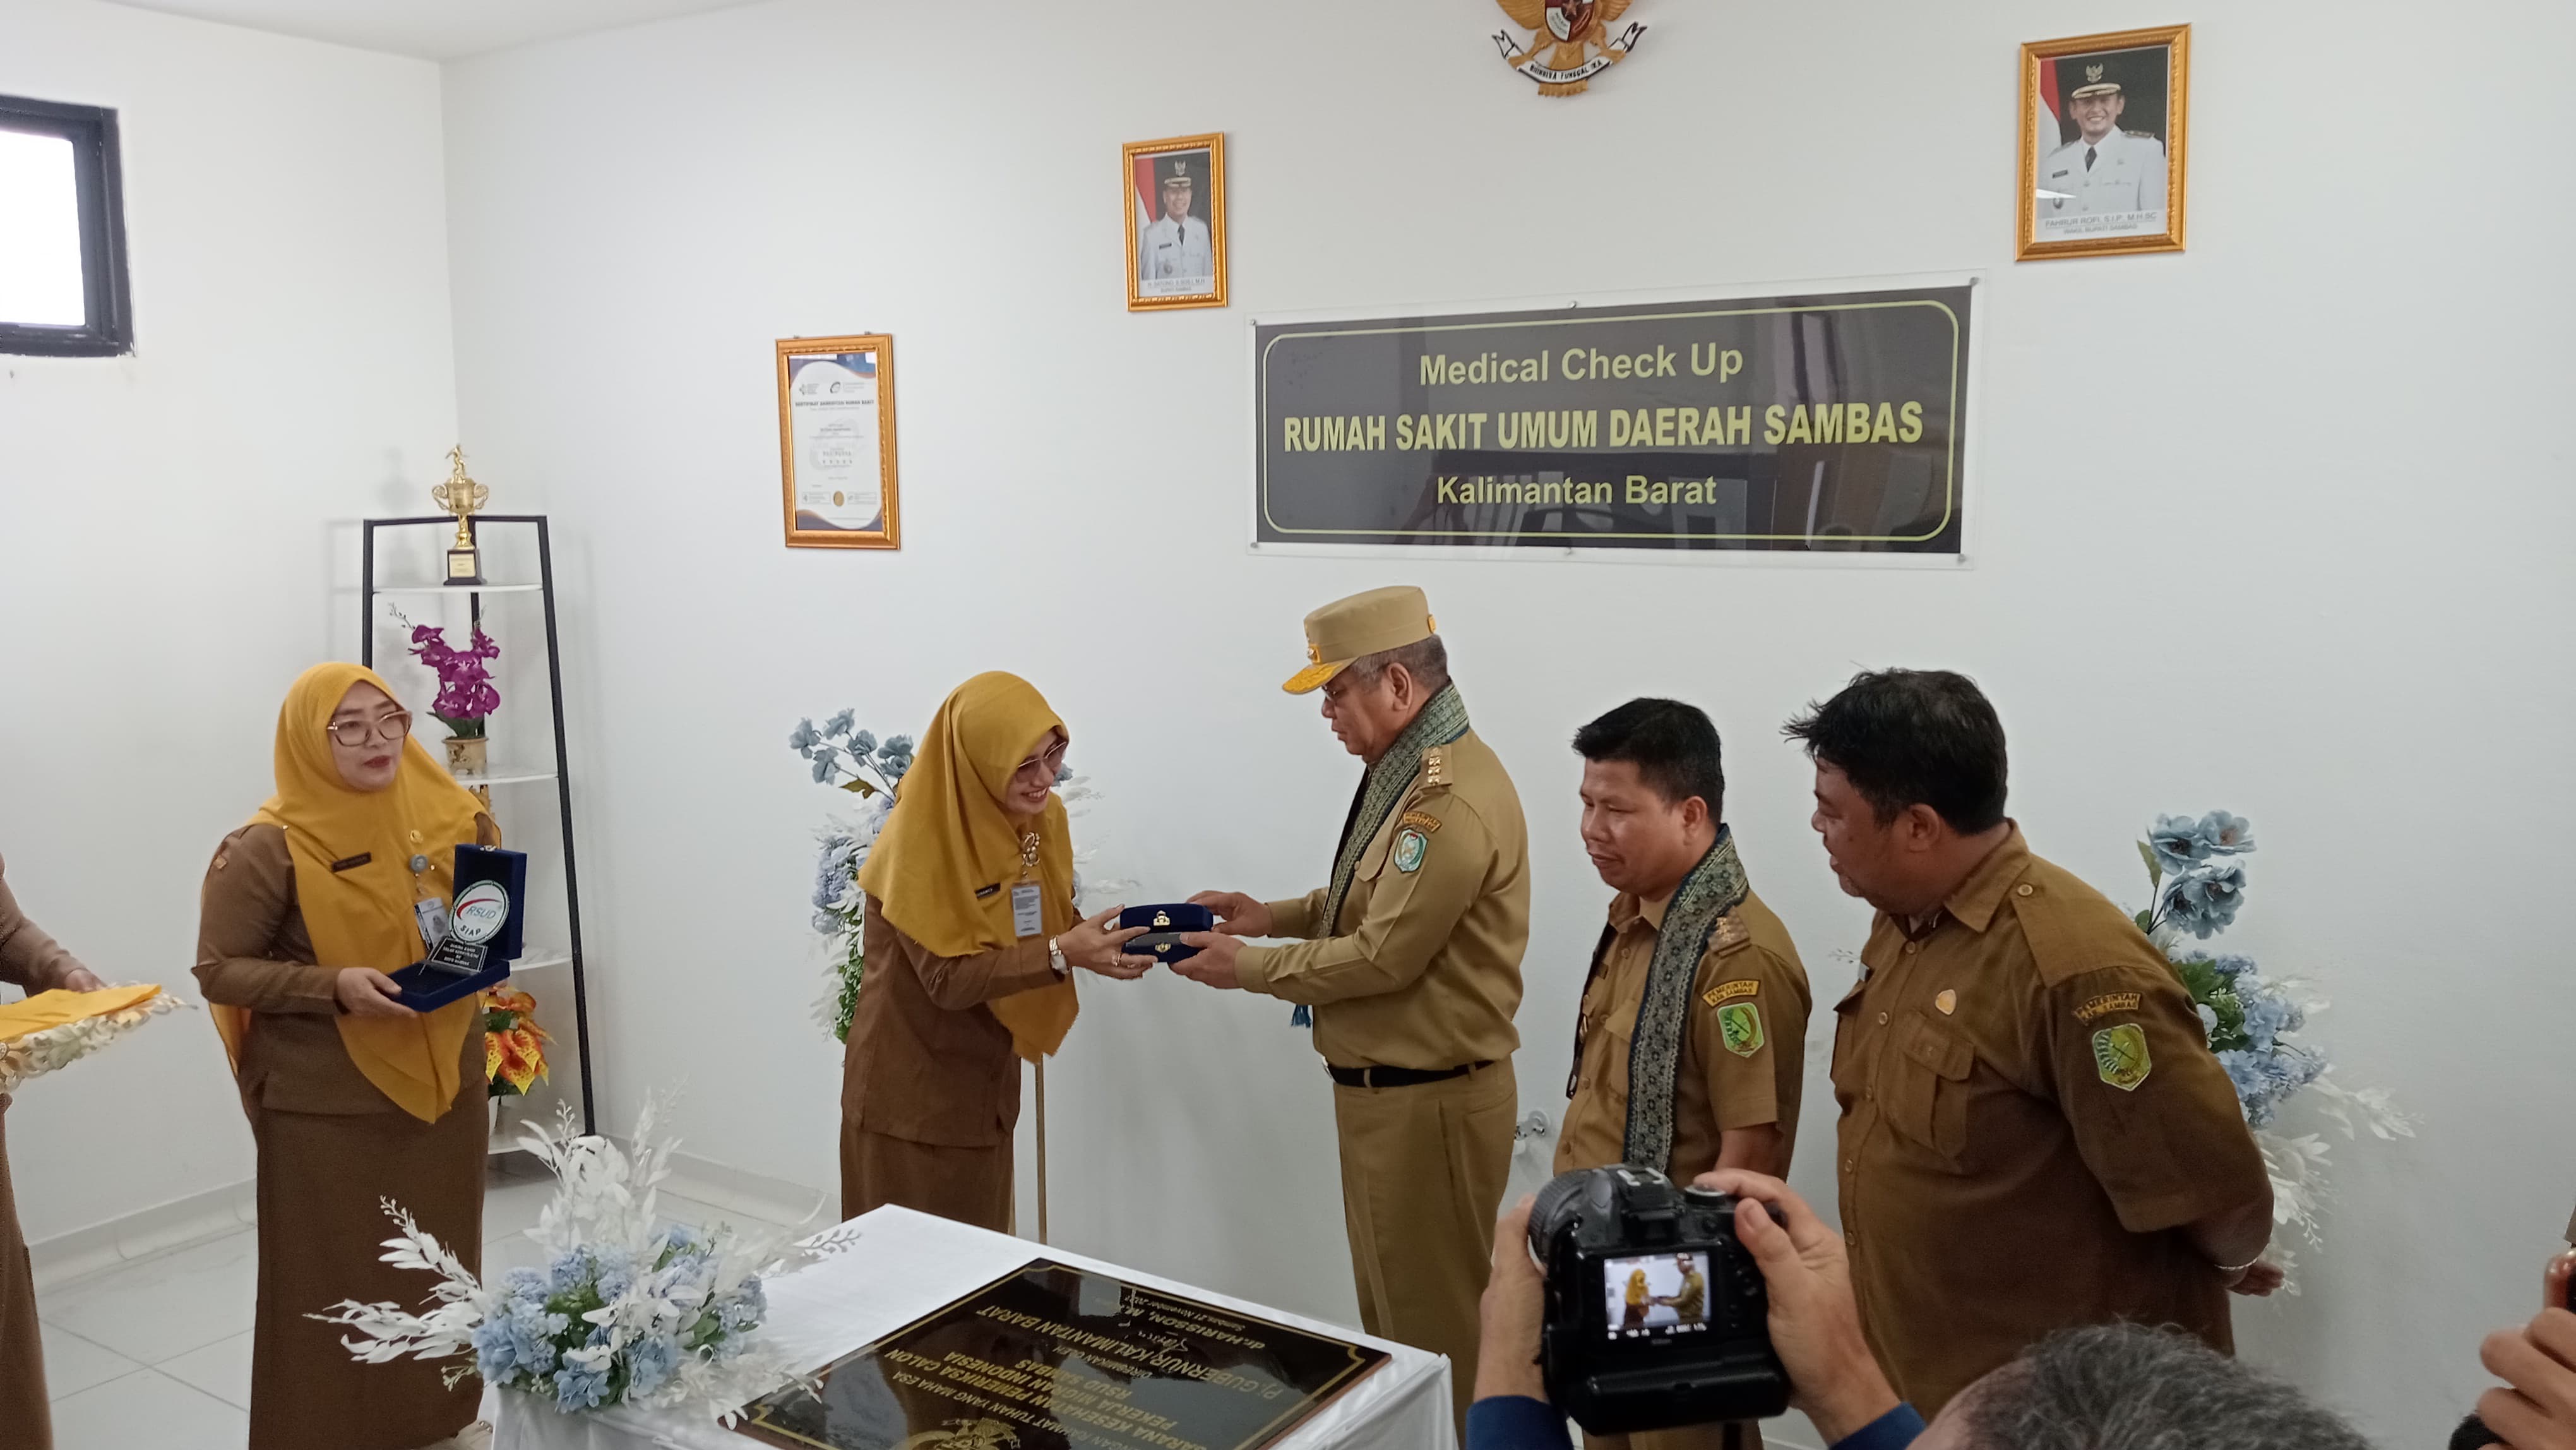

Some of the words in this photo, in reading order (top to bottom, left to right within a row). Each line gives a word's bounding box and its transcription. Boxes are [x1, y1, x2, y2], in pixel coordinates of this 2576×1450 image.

[2046, 219, 2078, 227] FAHRUR
[1419, 350, 1549, 386] Medical
[1561, 345, 1676, 381] Check
[1690, 340, 1743, 382] Up
[1284, 414, 1385, 450] RUMAH
[1396, 412, 1486, 450] SAKIT
[1498, 410, 1597, 448] UMUM
[1610, 405, 1751, 446] DAERAH
[1764, 401, 1923, 445] SAMBAS
[1438, 477, 1613, 505] Kalimantan
[1626, 474, 1717, 503] Barat
[466, 906, 496, 919] RSUD
[460, 925, 481, 936] SIAP
[975, 1304, 1042, 1329] BARAT
[1034, 1320, 1156, 1362] KALIMANTAN
[884, 1348, 941, 1372] CALON
[943, 1351, 1032, 1385] INDONESIA
[1014, 1358, 1085, 1385] SAMBAS
[892, 1370, 920, 1385] ESA
[917, 1379, 957, 1397] MAHA
[939, 1365, 1034, 1401] PEMERIKSA
[1083, 1379, 1133, 1400] RSUD
[953, 1391, 991, 1409] YANG
[1027, 1378, 1097, 1406] MIGRAN
[988, 1402, 1035, 1423] TUHAN
[1029, 1394, 1134, 1433] KESEHATAN
[1095, 1398, 1177, 1430] PEKERJA
